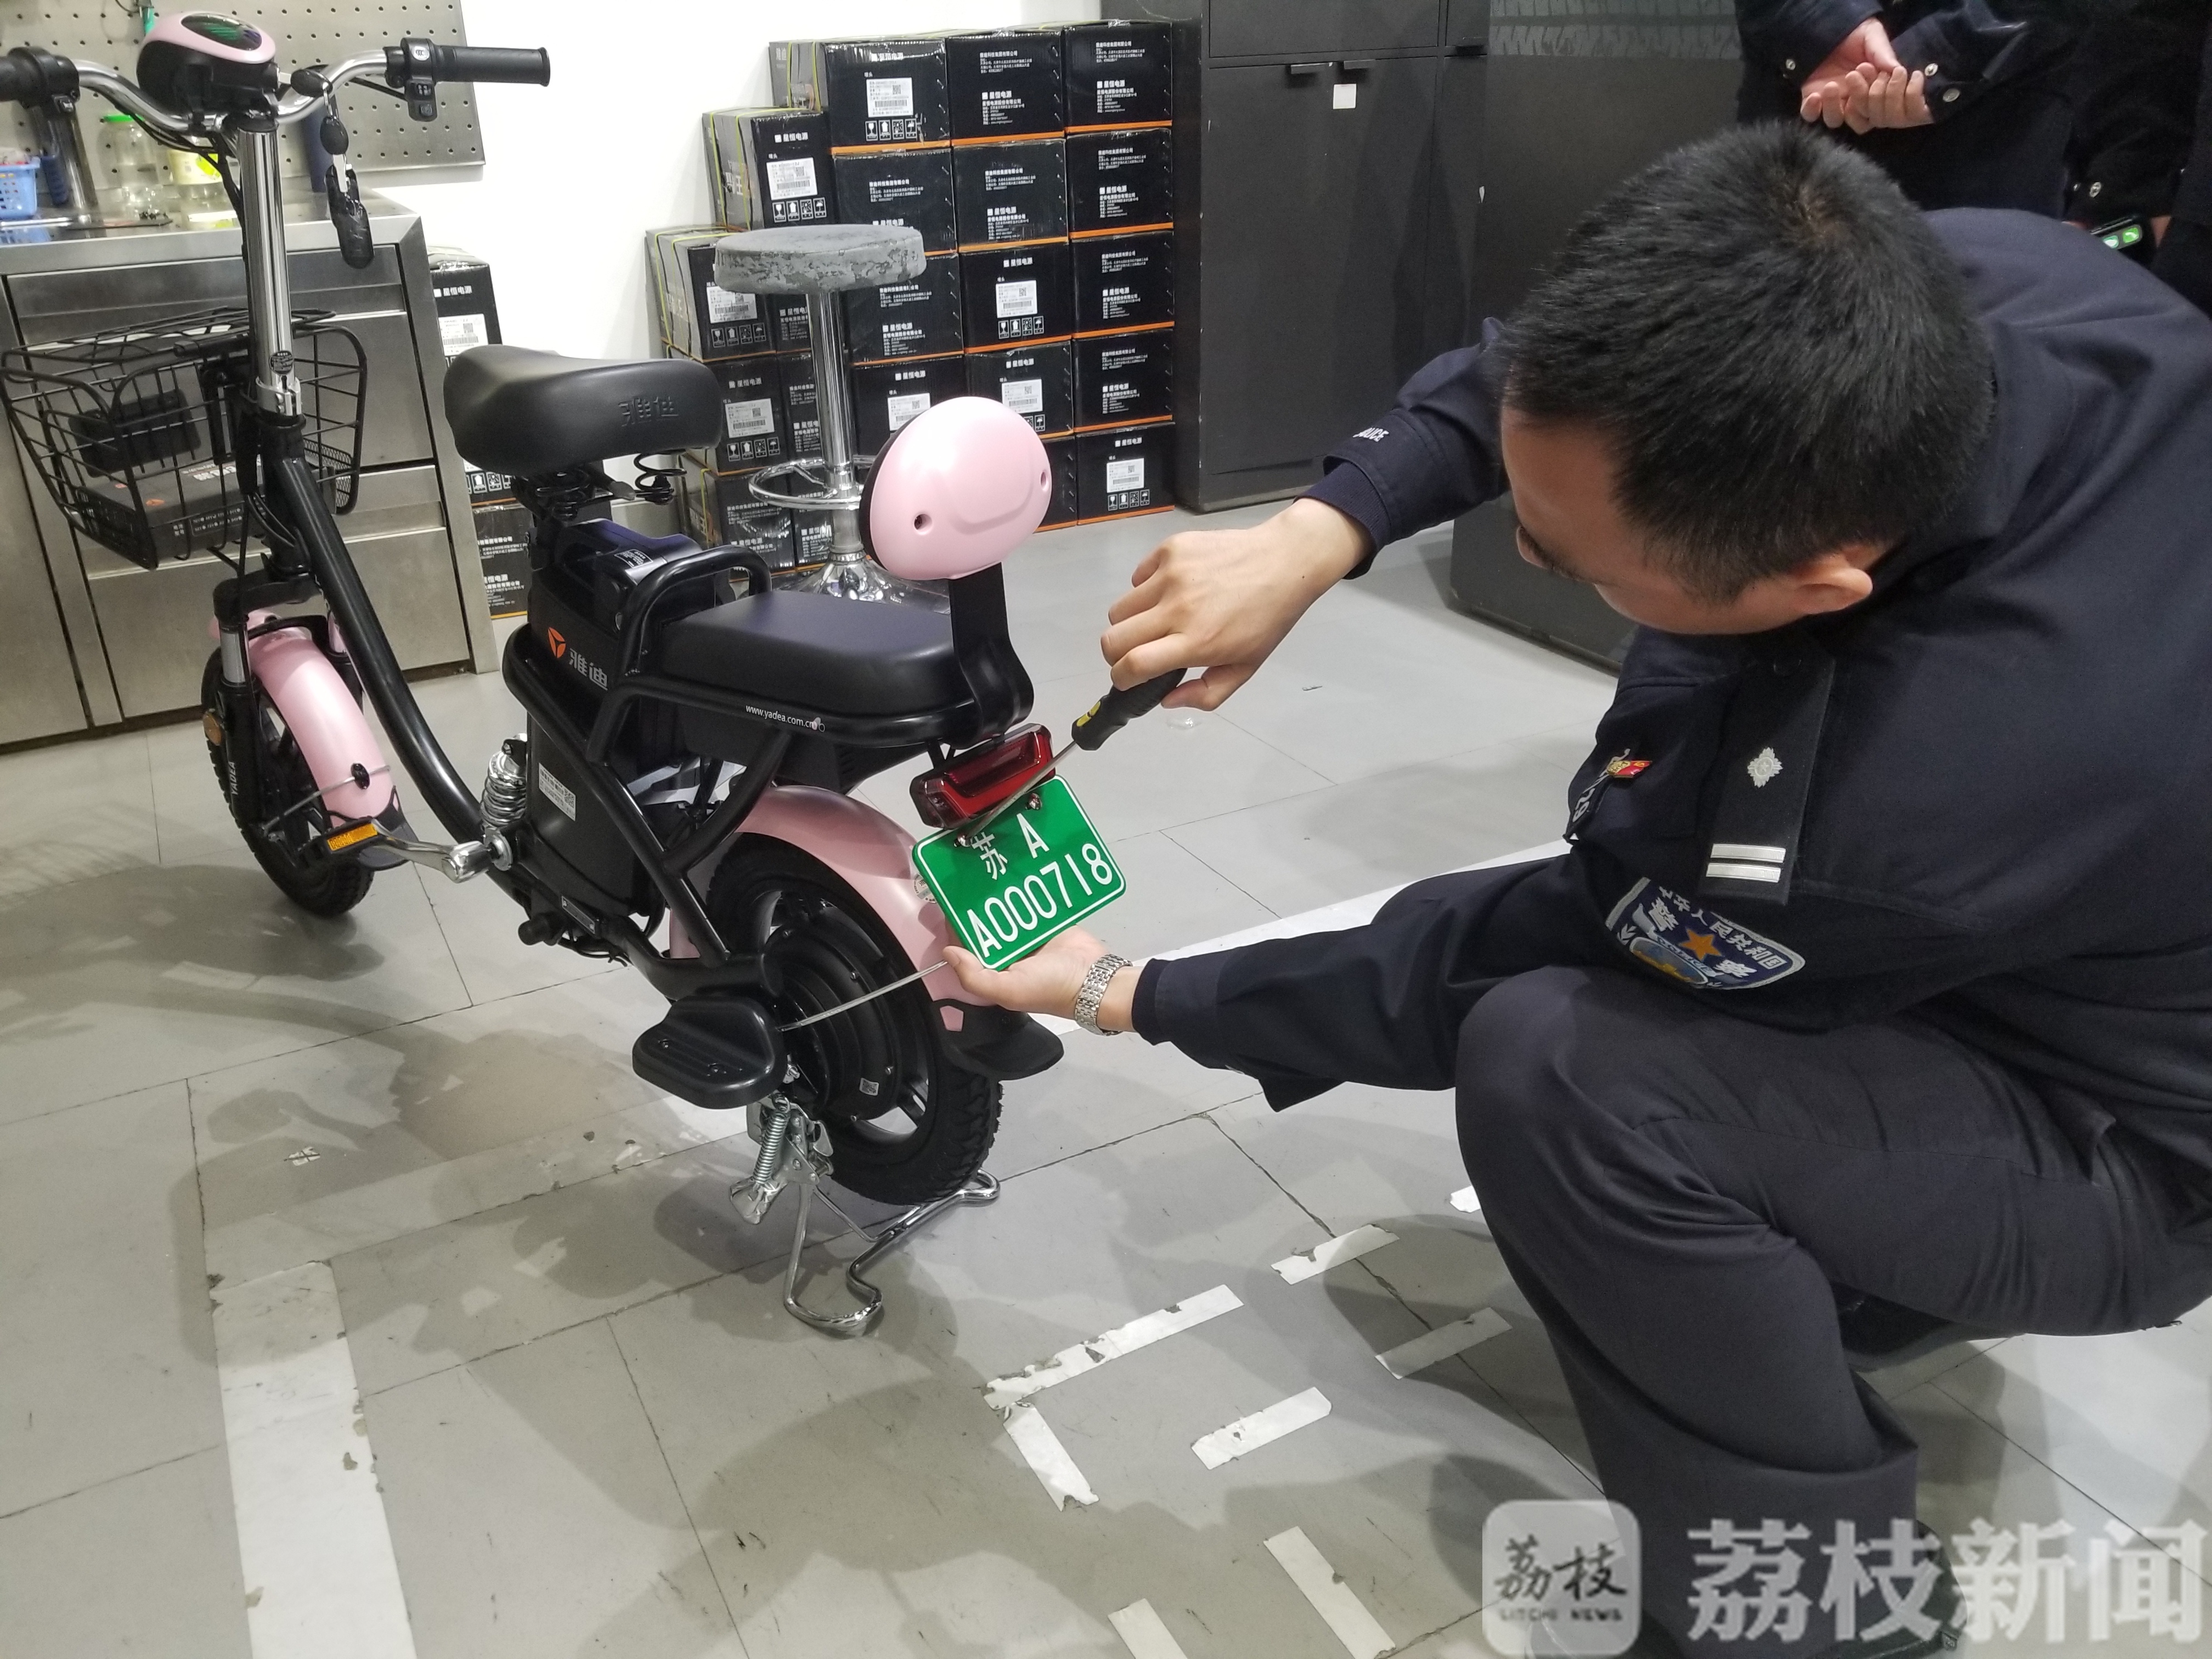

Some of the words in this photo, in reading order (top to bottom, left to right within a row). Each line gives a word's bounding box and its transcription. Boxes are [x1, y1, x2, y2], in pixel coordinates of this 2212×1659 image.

[990, 91, 1012, 99] 星恒电源
[783, 132, 808, 142] 星恒电源
[994, 206, 1017, 215] 星恒电源
[1011, 257, 1032, 267] 星恒电源
[443, 285, 472, 296] 星恒电源
[890, 322, 912, 331] 星恒电源
[1012, 358, 1034, 368] 星恒电源
[902, 370, 926, 380] 星恒电源
[1122, 437, 1142, 446] 星恒电源
[569, 648, 608, 691] 雅迪
[746, 705, 816, 729] www.yadea.com.cn
[228, 761, 238, 795] YADEA
[972, 832, 1008, 881] 苏
[1017, 813, 1050, 859] A
[967, 843, 1113, 958] A000718
